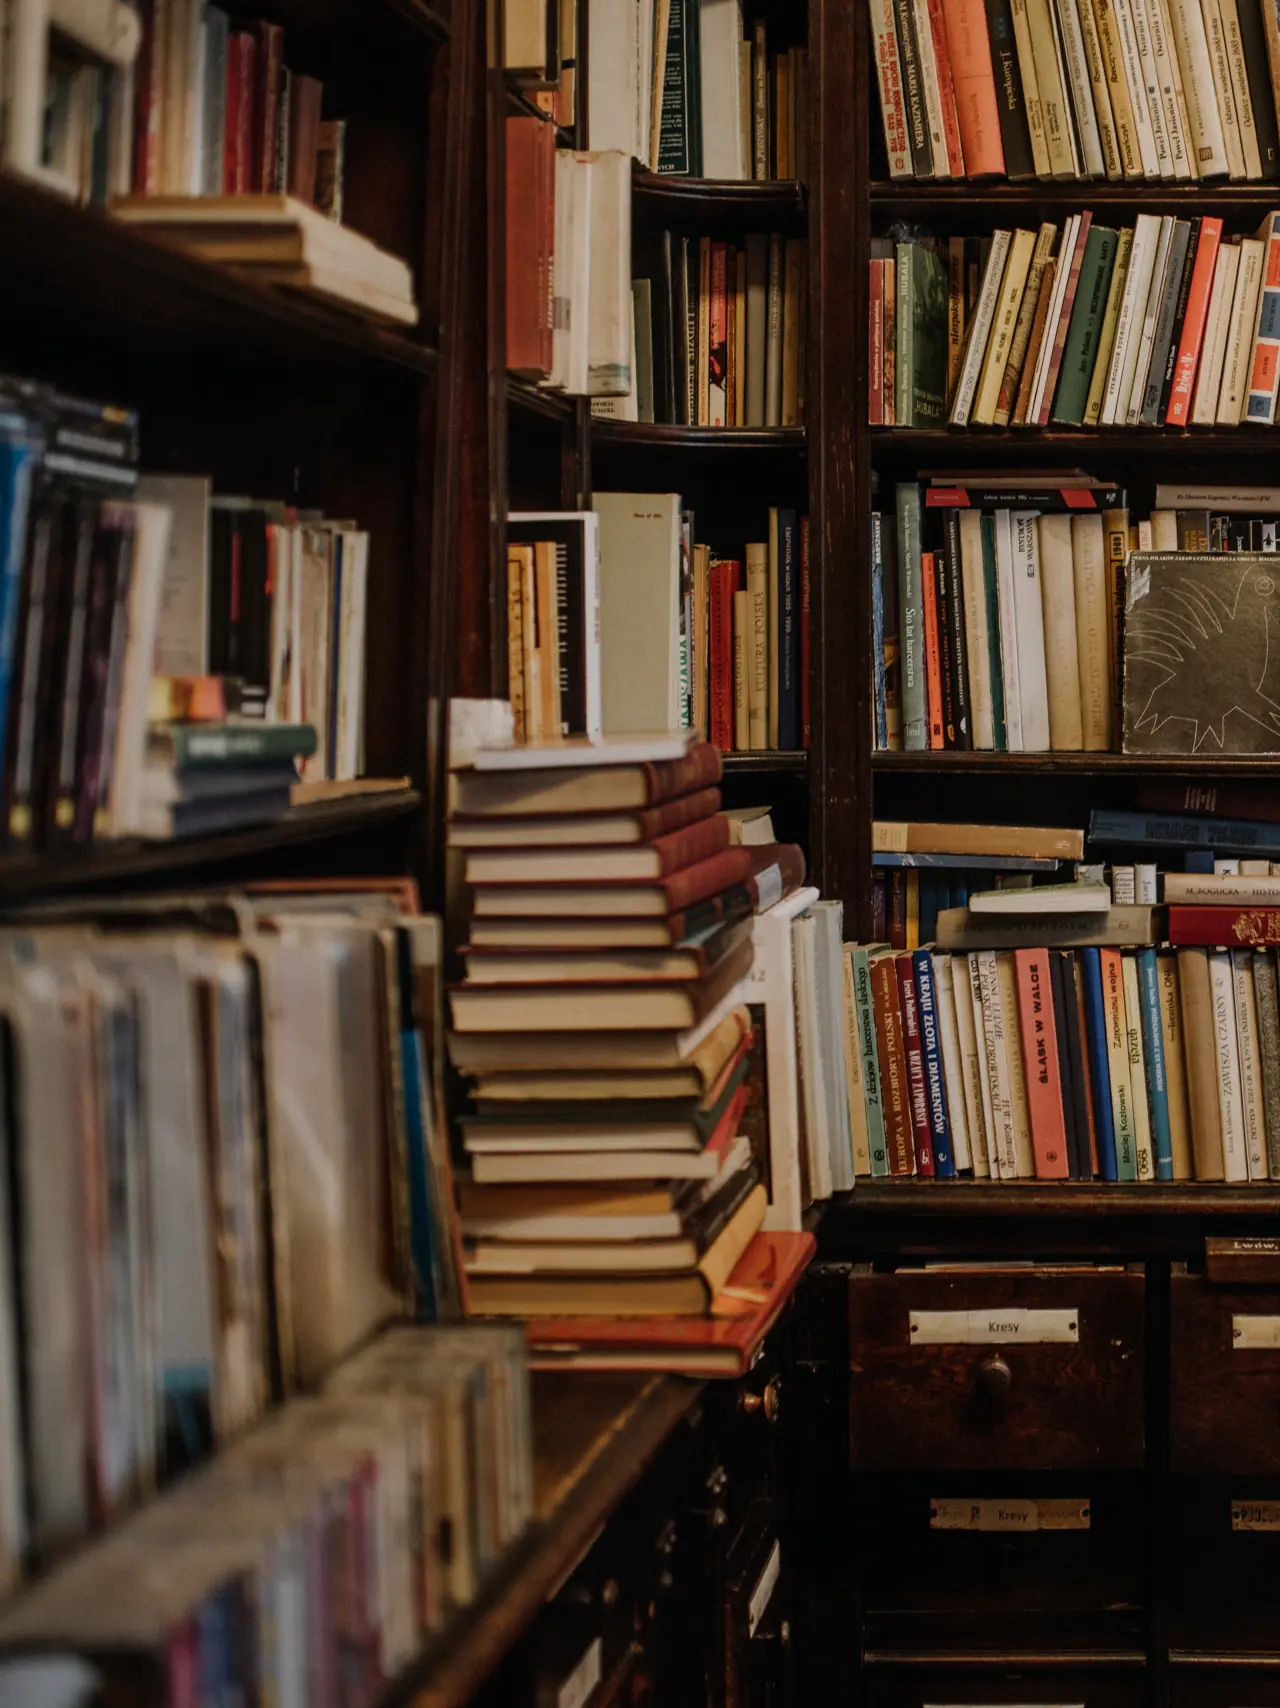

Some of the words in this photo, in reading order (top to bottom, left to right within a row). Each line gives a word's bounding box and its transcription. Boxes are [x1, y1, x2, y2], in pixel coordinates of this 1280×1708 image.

[908, 64, 917, 95] MARIA
[911, 97, 924, 148] KAZIMIERA
[1148, 98, 1164, 135] Jasienica
[1164, 98, 1181, 136] Jasienica
[1156, 136, 1167, 160] Paweł
[1173, 136, 1183, 160] Paweł
[1113, 535, 1123, 557] 1969
[754, 592, 764, 634] POLSKA
[905, 608, 916, 624] Sto
[907, 626, 915, 637] lat
[755, 641, 765, 692] KULTURA
[907, 640, 915, 687] harcerstwa
[919, 959, 929, 975] W
[1108, 962, 1118, 993] wojna
[1163, 968, 1173, 988] ONI
[921, 974, 932, 1011] KRAJU
[1029, 963, 1041, 1013] WALCE
[1034, 1019, 1044, 1033] W
[1166, 991, 1177, 1029] Torańska
[1216, 993, 1231, 1041] CZARNY
[861, 1009, 873, 1056] harcerstwa
[884, 1011, 896, 1052] POLSKI
[925, 1014, 937, 1050] ZŁOTA
[1036, 1037, 1049, 1084] ŚLĄSK
[1220, 1043, 1233, 1096] ZAWISZA
[868, 1096, 879, 1105] Z
[889, 1055, 902, 1112] ROZBIORY
[929, 1061, 945, 1134] DIAMENTÓW
[1117, 1084, 1128, 1131] Kozłowski
[896, 1126, 908, 1171] EUROPA
[1121, 1134, 1132, 1163] Maciej
[1138, 1148, 1148, 1174] 1990
[1233, 1242, 1278, 1250] Lwów,
[988, 1322, 1019, 1334] Kresy
[998, 1509, 1028, 1522] Kresy
